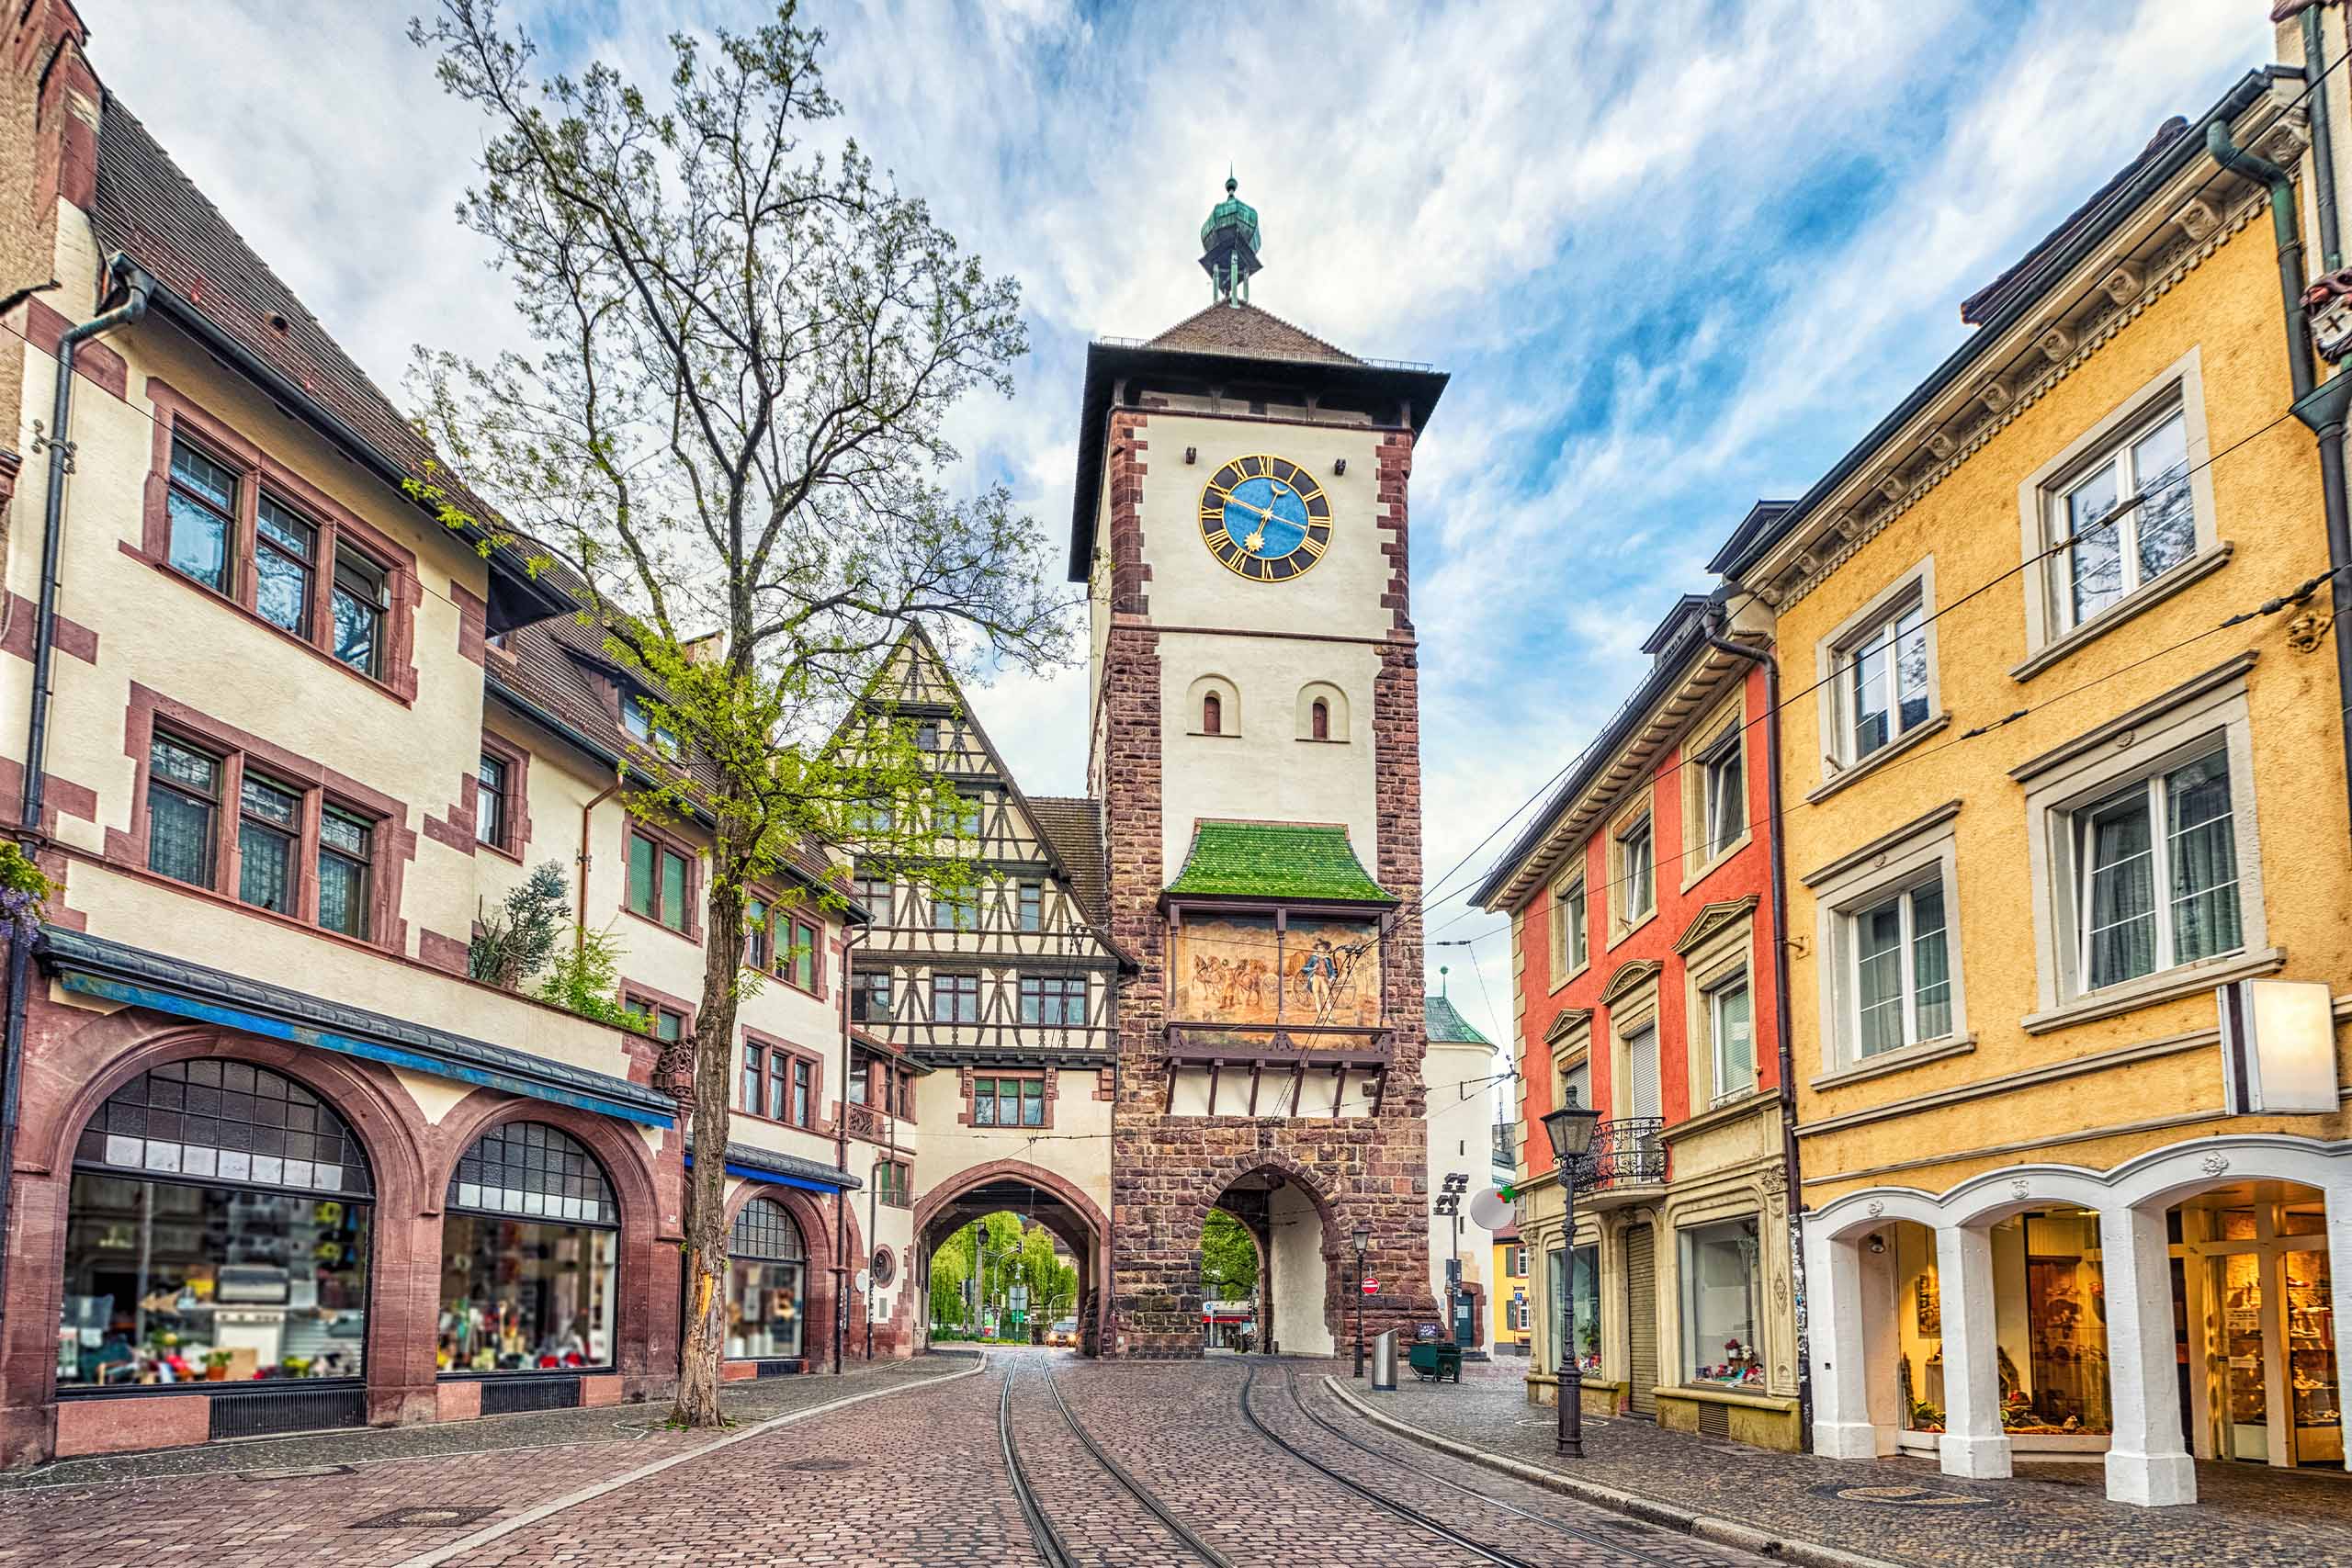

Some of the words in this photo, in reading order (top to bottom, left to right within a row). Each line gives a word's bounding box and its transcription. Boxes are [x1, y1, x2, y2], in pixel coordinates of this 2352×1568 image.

[1227, 459, 1248, 481] XI
[1258, 456, 1273, 476] XII
[1287, 468, 1298, 484] I
[1303, 489, 1324, 502] II
[1201, 506, 1222, 519] IX
[1309, 516, 1330, 528] III
[1206, 528, 1230, 553] VIII
[1301, 536, 1326, 558] IIII
[1227, 547, 1247, 573] VII
[1261, 558, 1273, 579] VI
[1288, 556, 1302, 574] V
